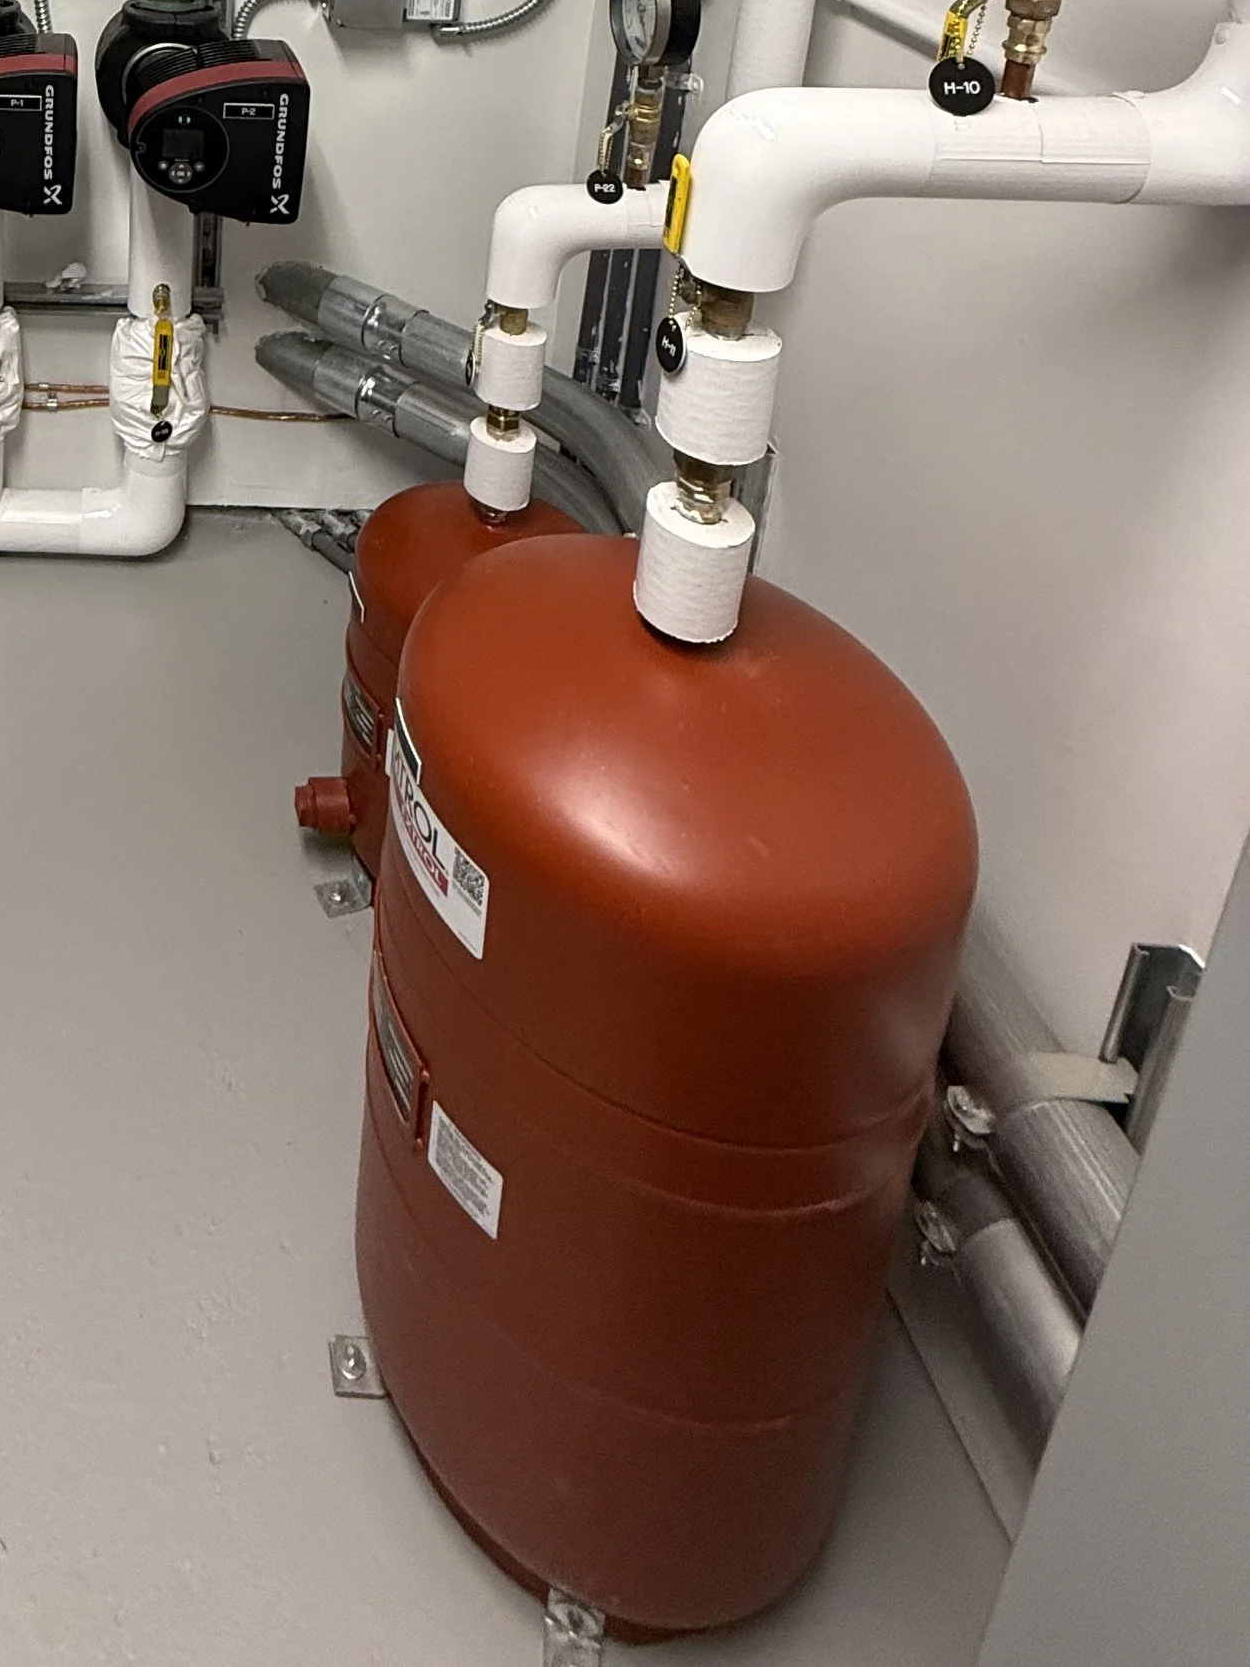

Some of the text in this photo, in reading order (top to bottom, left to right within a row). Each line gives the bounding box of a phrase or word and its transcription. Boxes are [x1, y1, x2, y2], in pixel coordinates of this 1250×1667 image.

[943, 80, 981, 95] H-10
[10, 98, 25, 107] P-1
[241, 106, 257, 116] P-2
[43, 84, 55, 181] GRUNDFOS
[272, 92, 290, 190] GRUNDFOS
[593, 183, 618, 193] P-22
